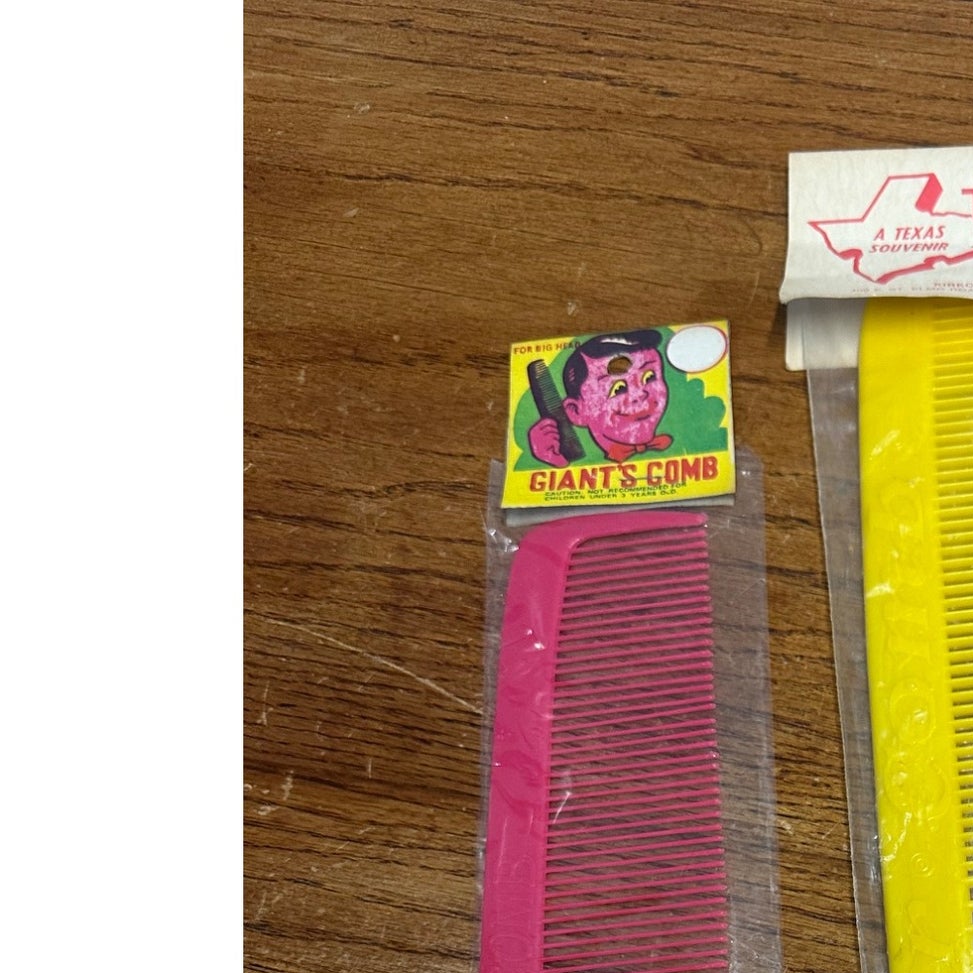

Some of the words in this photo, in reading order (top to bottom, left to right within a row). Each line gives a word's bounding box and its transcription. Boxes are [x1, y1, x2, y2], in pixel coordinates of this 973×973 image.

[873, 227, 885, 241] A
[895, 225, 946, 241] TEXAS
[869, 242, 949, 254] SOUVENIR
[514, 346, 532, 355] FOR
[535, 344, 553, 353] BIG
[530, 464, 636, 492] GIANT'S
[647, 456, 718, 485] COMB
[608, 484, 669, 493] RECOMMENDED
